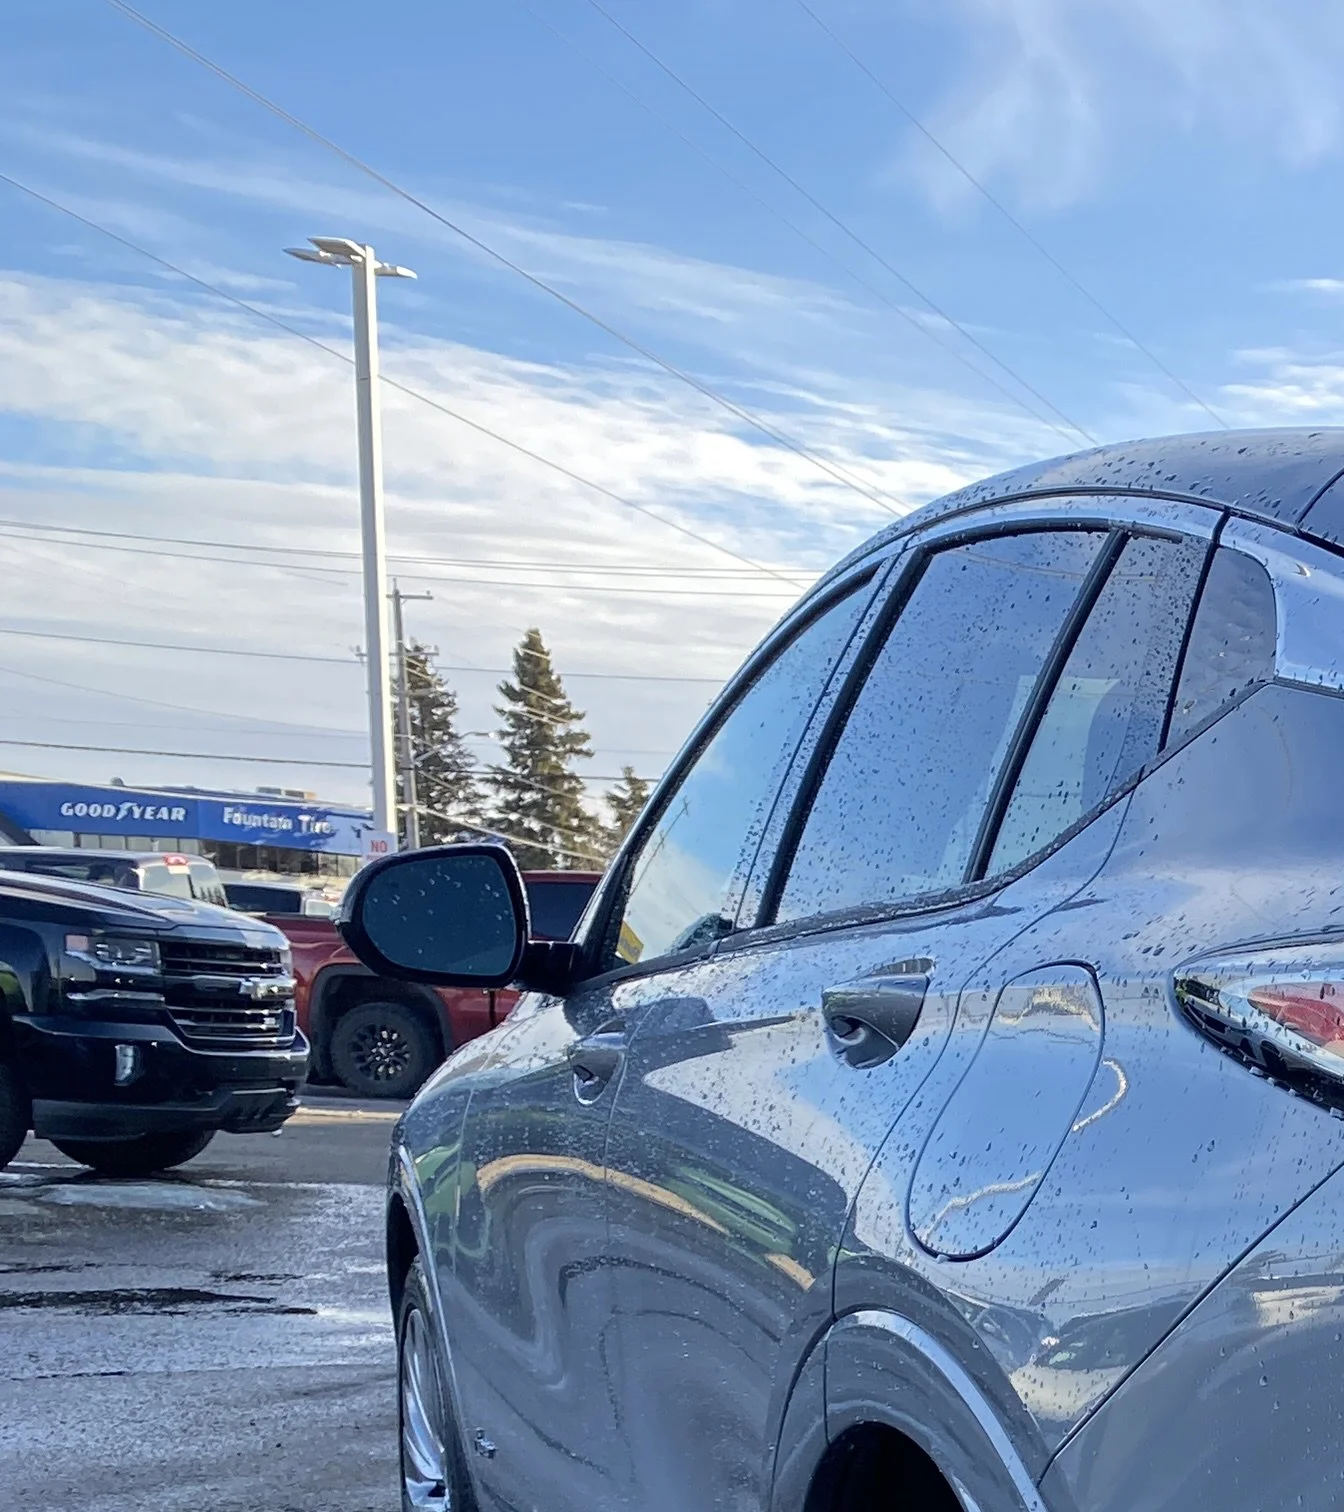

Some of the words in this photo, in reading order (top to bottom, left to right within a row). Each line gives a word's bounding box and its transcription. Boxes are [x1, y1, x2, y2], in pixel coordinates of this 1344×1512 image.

[60, 801, 186, 821] GOODYEAR
[223, 806, 293, 831] Fountain
[298, 814, 334, 834] Tire
[370, 840, 388, 853] NO
